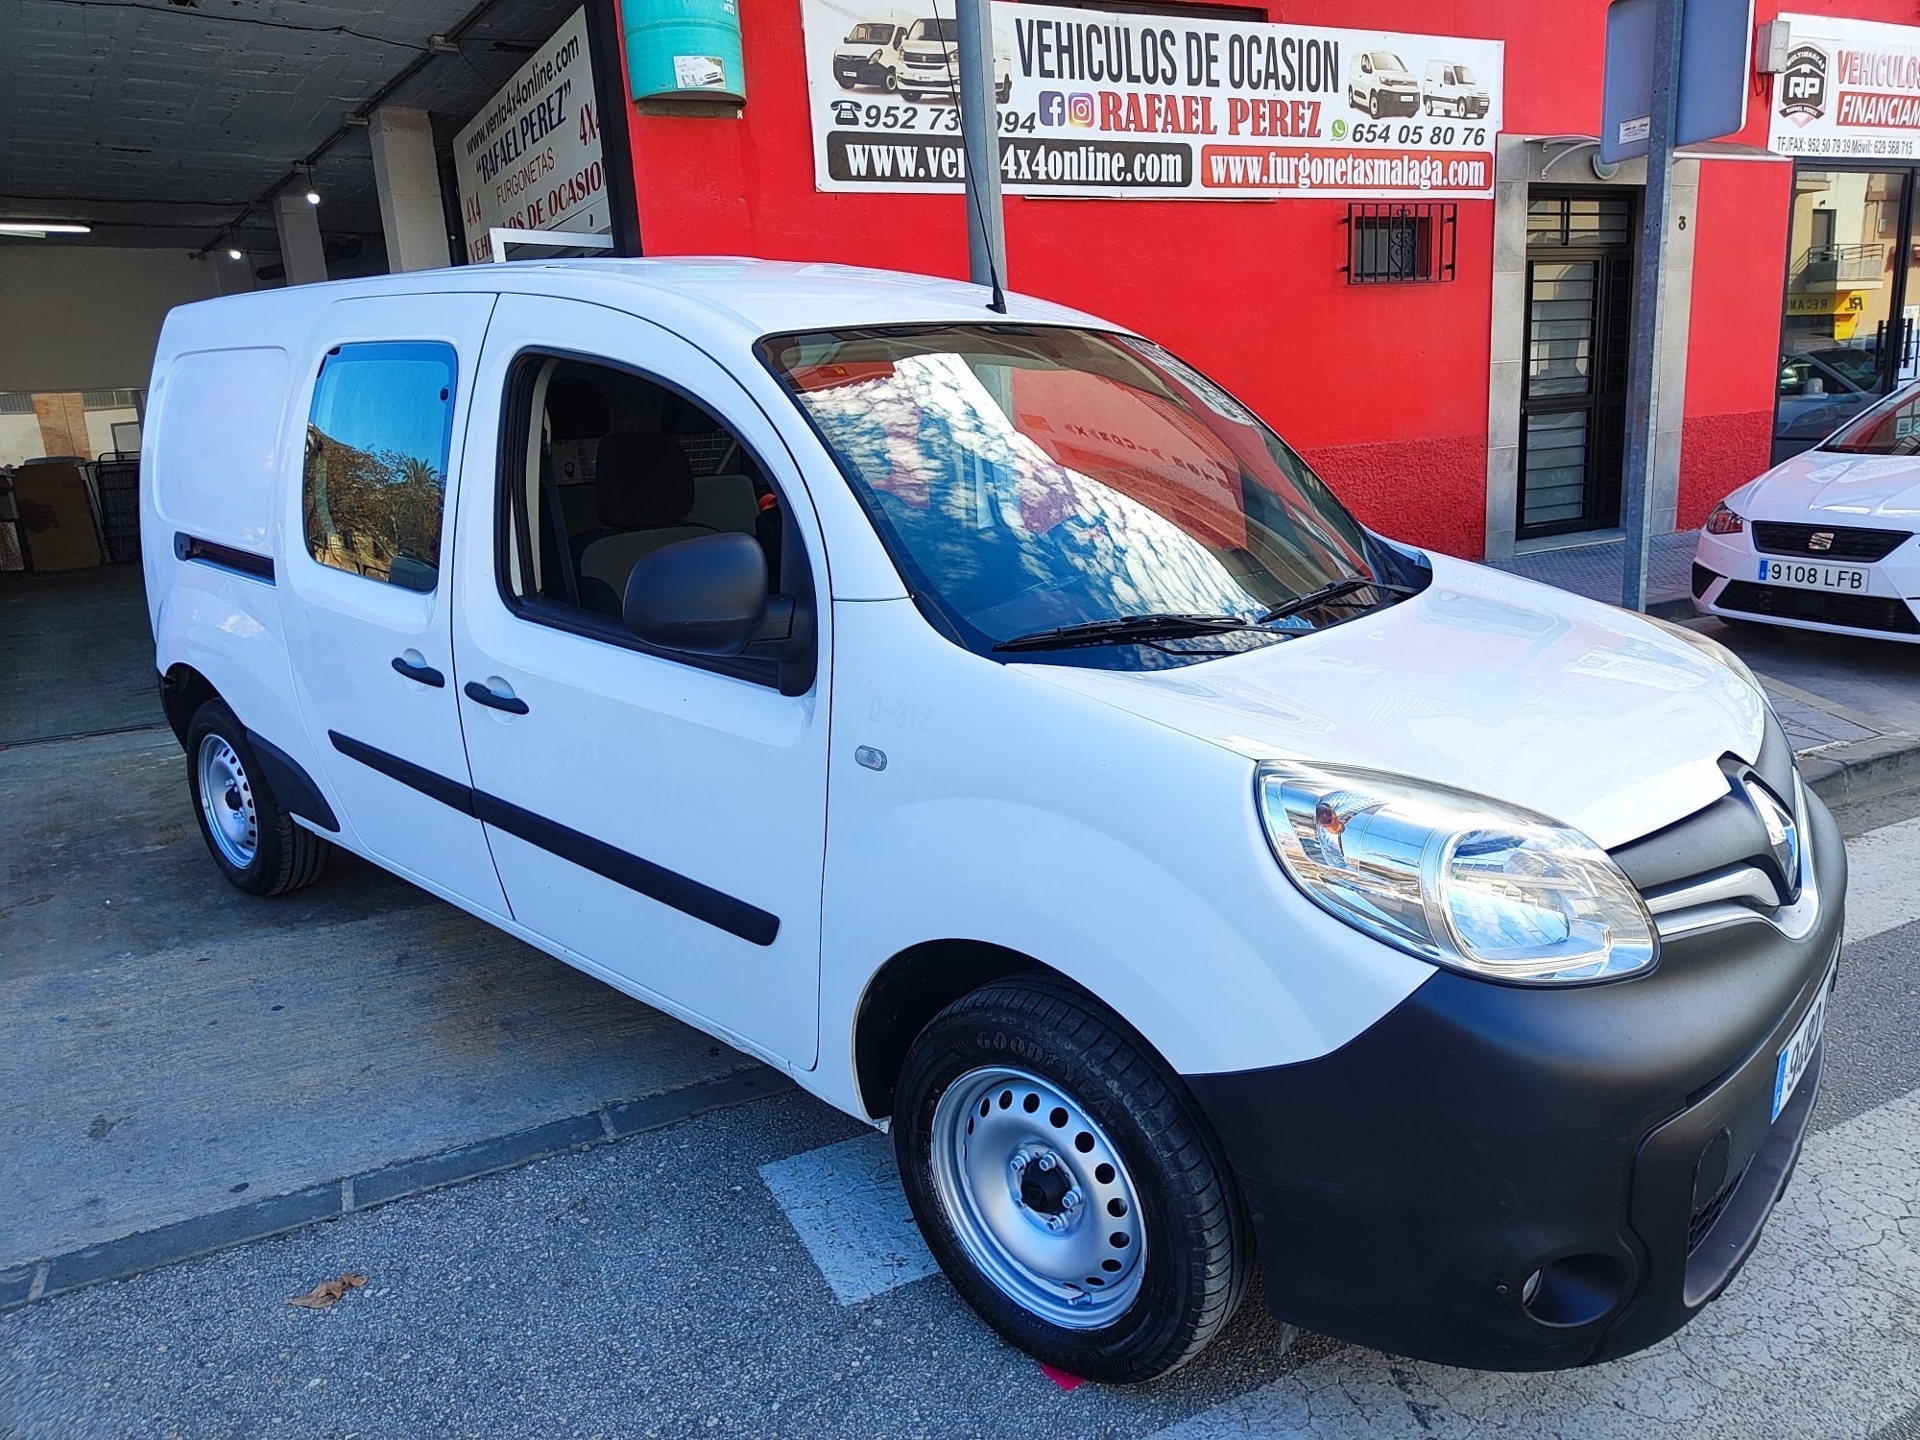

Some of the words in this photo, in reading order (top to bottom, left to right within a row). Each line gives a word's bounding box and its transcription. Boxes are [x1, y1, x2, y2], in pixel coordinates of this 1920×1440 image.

[1015, 18, 1177, 86] VEHICULOS
[1185, 31, 1220, 88] DE
[1229, 34, 1339, 93] OCASION
[1837, 50, 1920, 89] VEHICULO
[466, 35, 579, 156] www.venta4x4online.com
[1788, 76, 1820, 99] RP
[580, 99, 600, 146] 4X
[864, 104, 918, 130] 952
[1099, 90, 1218, 135] RAFAEL
[1227, 97, 1322, 138] PEREZ
[1351, 123, 1391, 144] 654
[1397, 124, 1423, 144] 05
[1429, 125, 1455, 145] 80
[1462, 127, 1486, 146] 76
[1807, 138, 1819, 153] 952
[1821, 138, 1830, 153] 50
[496, 146, 555, 206] FURGONETAS
[1210, 151, 1485, 189] www.furgonetasmalaga.com
[527, 198, 546, 230] DE
[1678, 215, 1687, 231] 3
[1771, 563, 1817, 585] 9108
[1824, 569, 1863, 589] LFB
